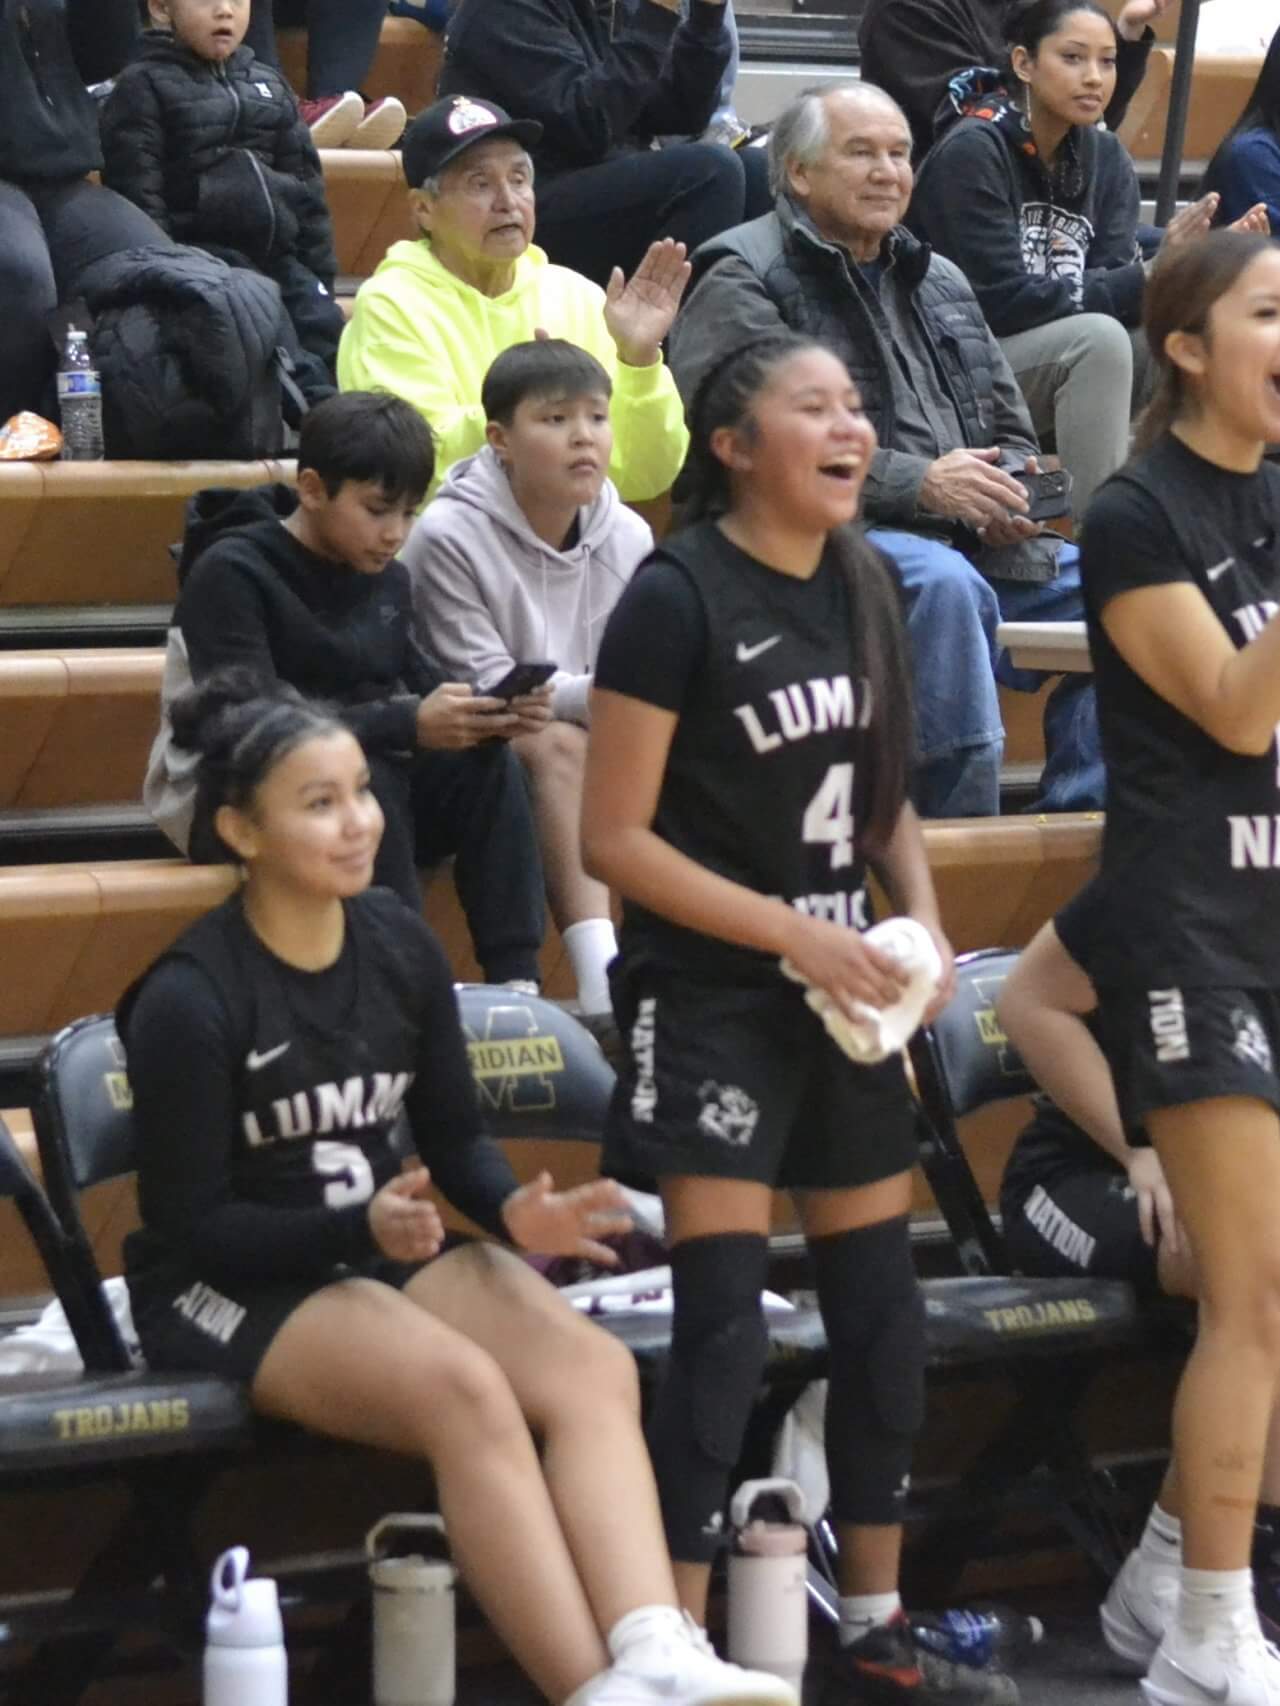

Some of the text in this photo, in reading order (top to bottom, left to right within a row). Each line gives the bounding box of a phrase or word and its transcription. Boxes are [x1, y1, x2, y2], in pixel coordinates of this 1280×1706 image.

[802, 762, 854, 870] 4
[1148, 988, 1190, 1062] TION
[243, 1072, 415, 1146] LUMM
[312, 1141, 374, 1210] 5
[172, 1281, 248, 1343] ATION
[983, 1299, 1097, 1335] TROJANS
[54, 1398, 189, 1439] TROJANS
